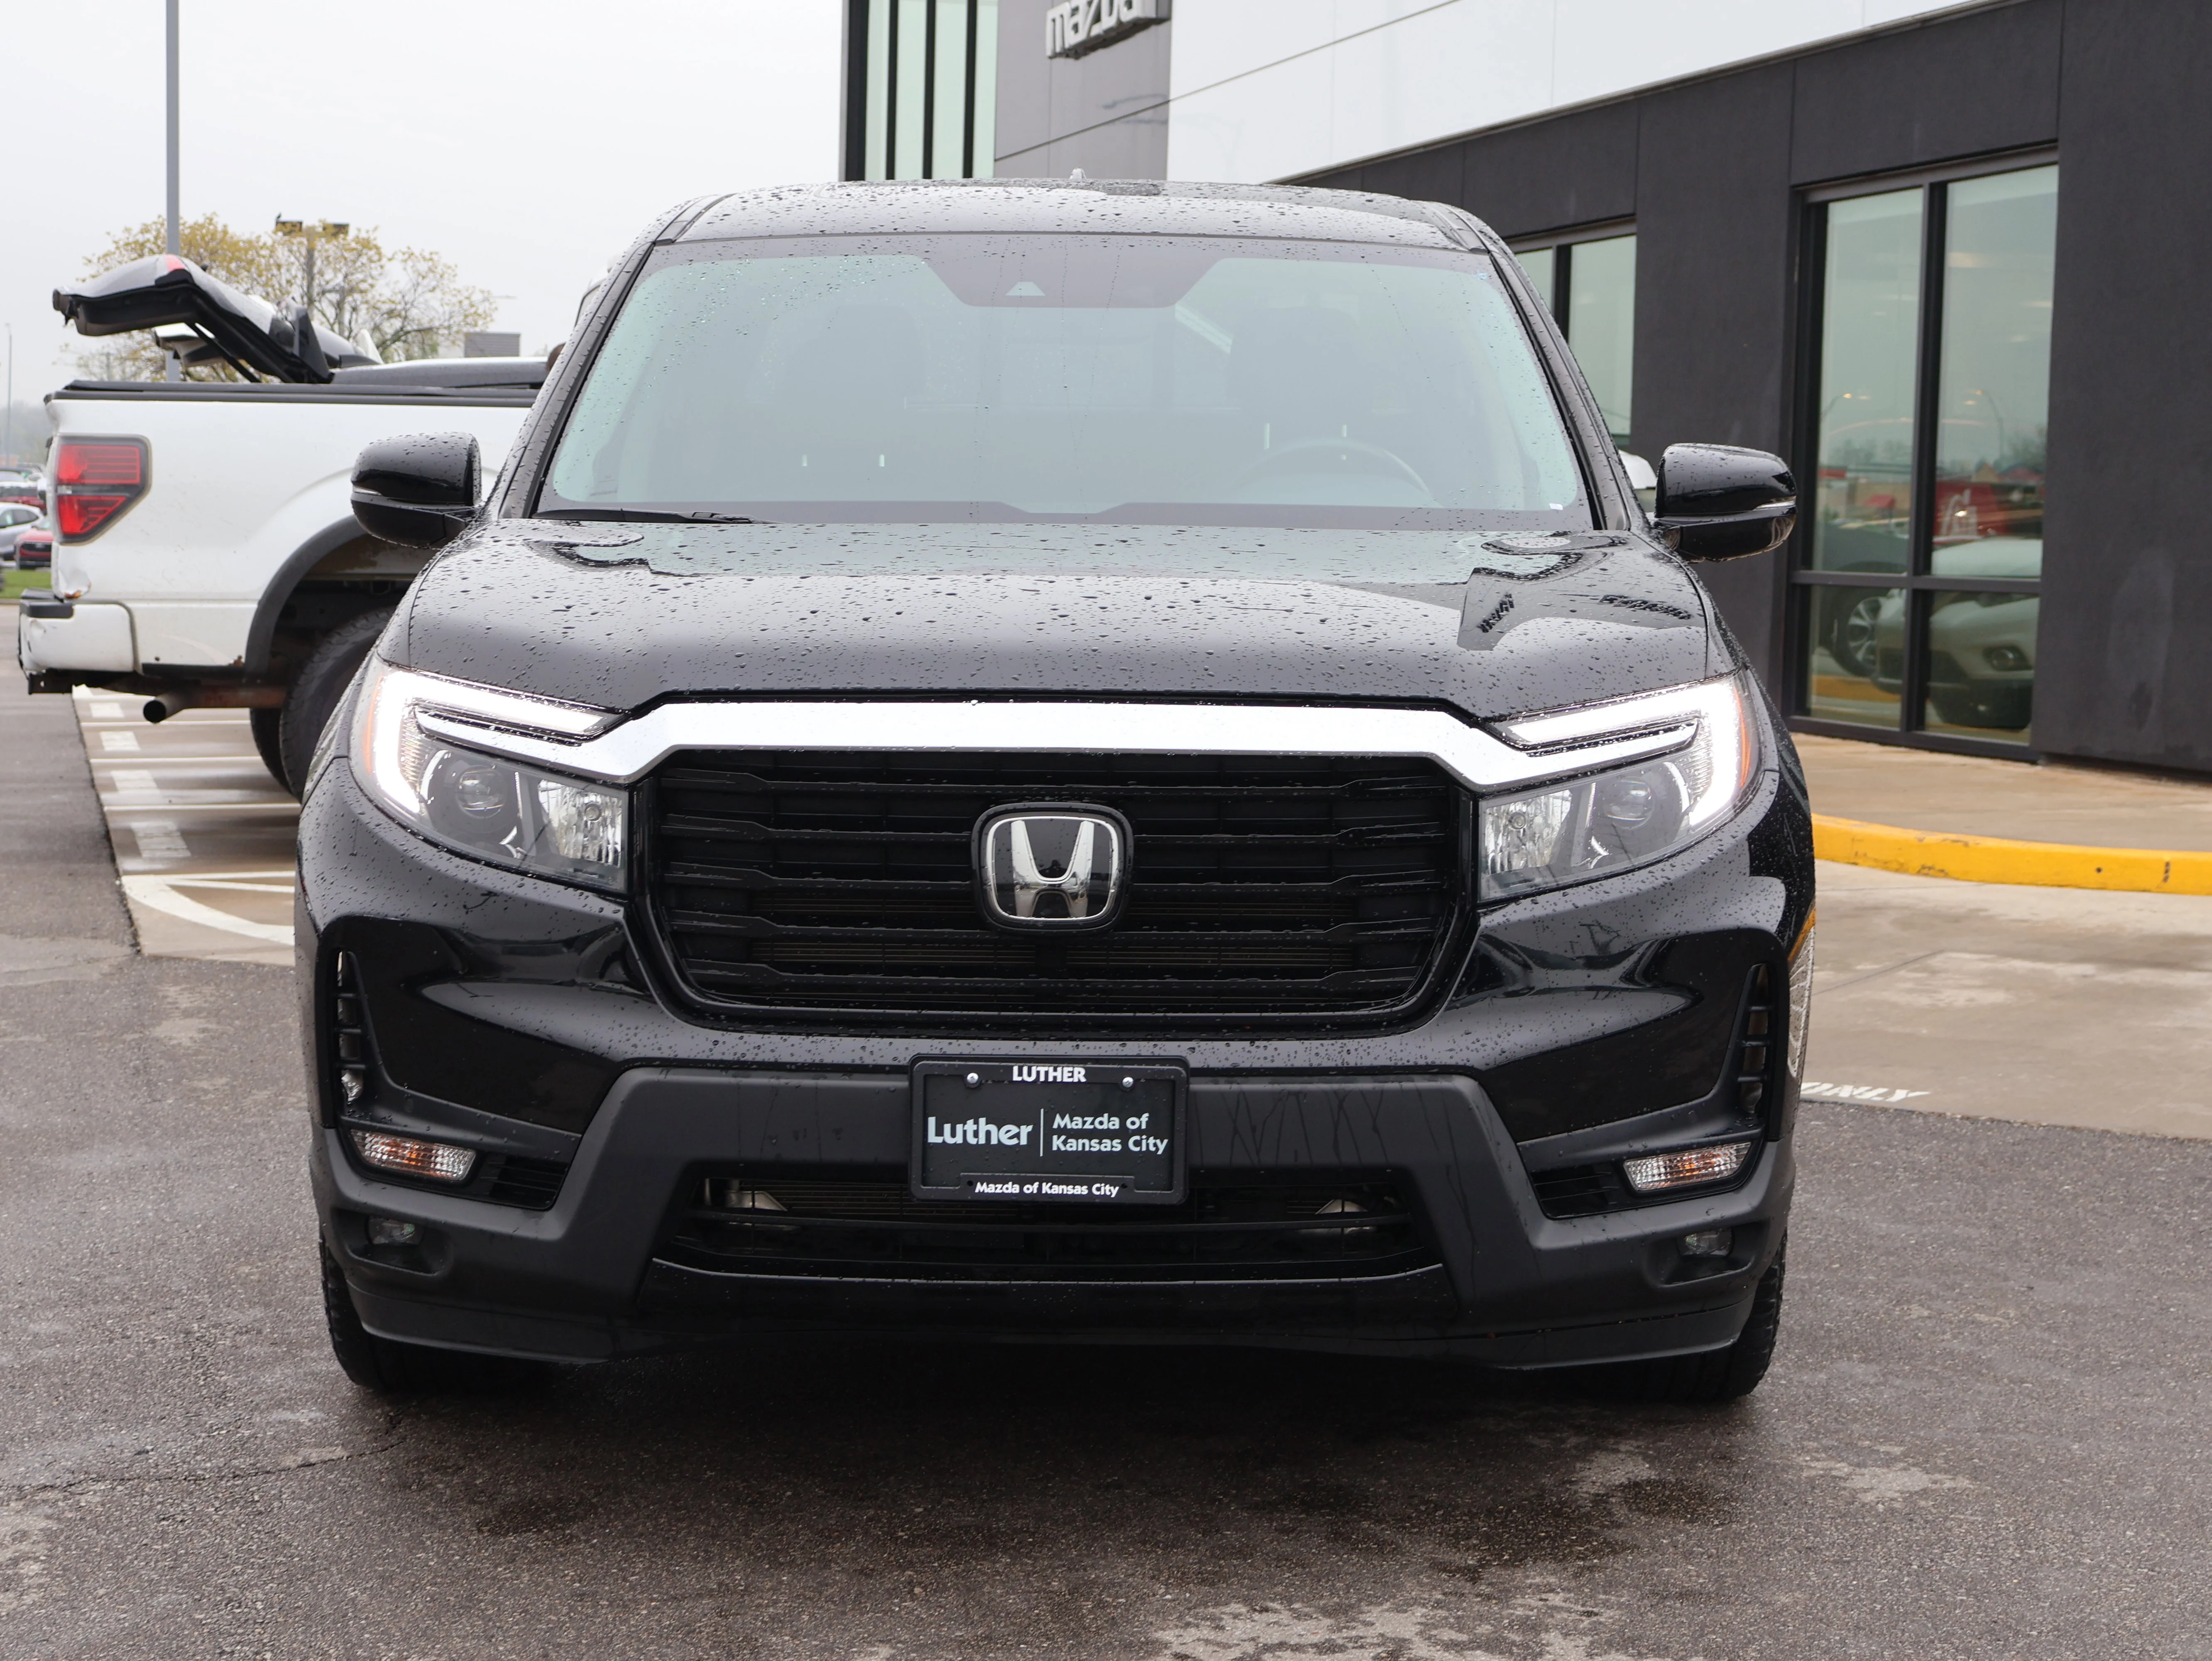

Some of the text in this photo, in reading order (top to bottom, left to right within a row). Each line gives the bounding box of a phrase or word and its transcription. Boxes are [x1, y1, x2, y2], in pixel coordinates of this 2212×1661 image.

[1012, 1065, 1087, 1083] LUTHER
[1052, 1112, 1150, 1129] Mazda of
[927, 1116, 1033, 1145] Luther
[1052, 1134, 1169, 1155] Kansas City
[974, 1181, 1120, 1198] Mazda of Kansas City
